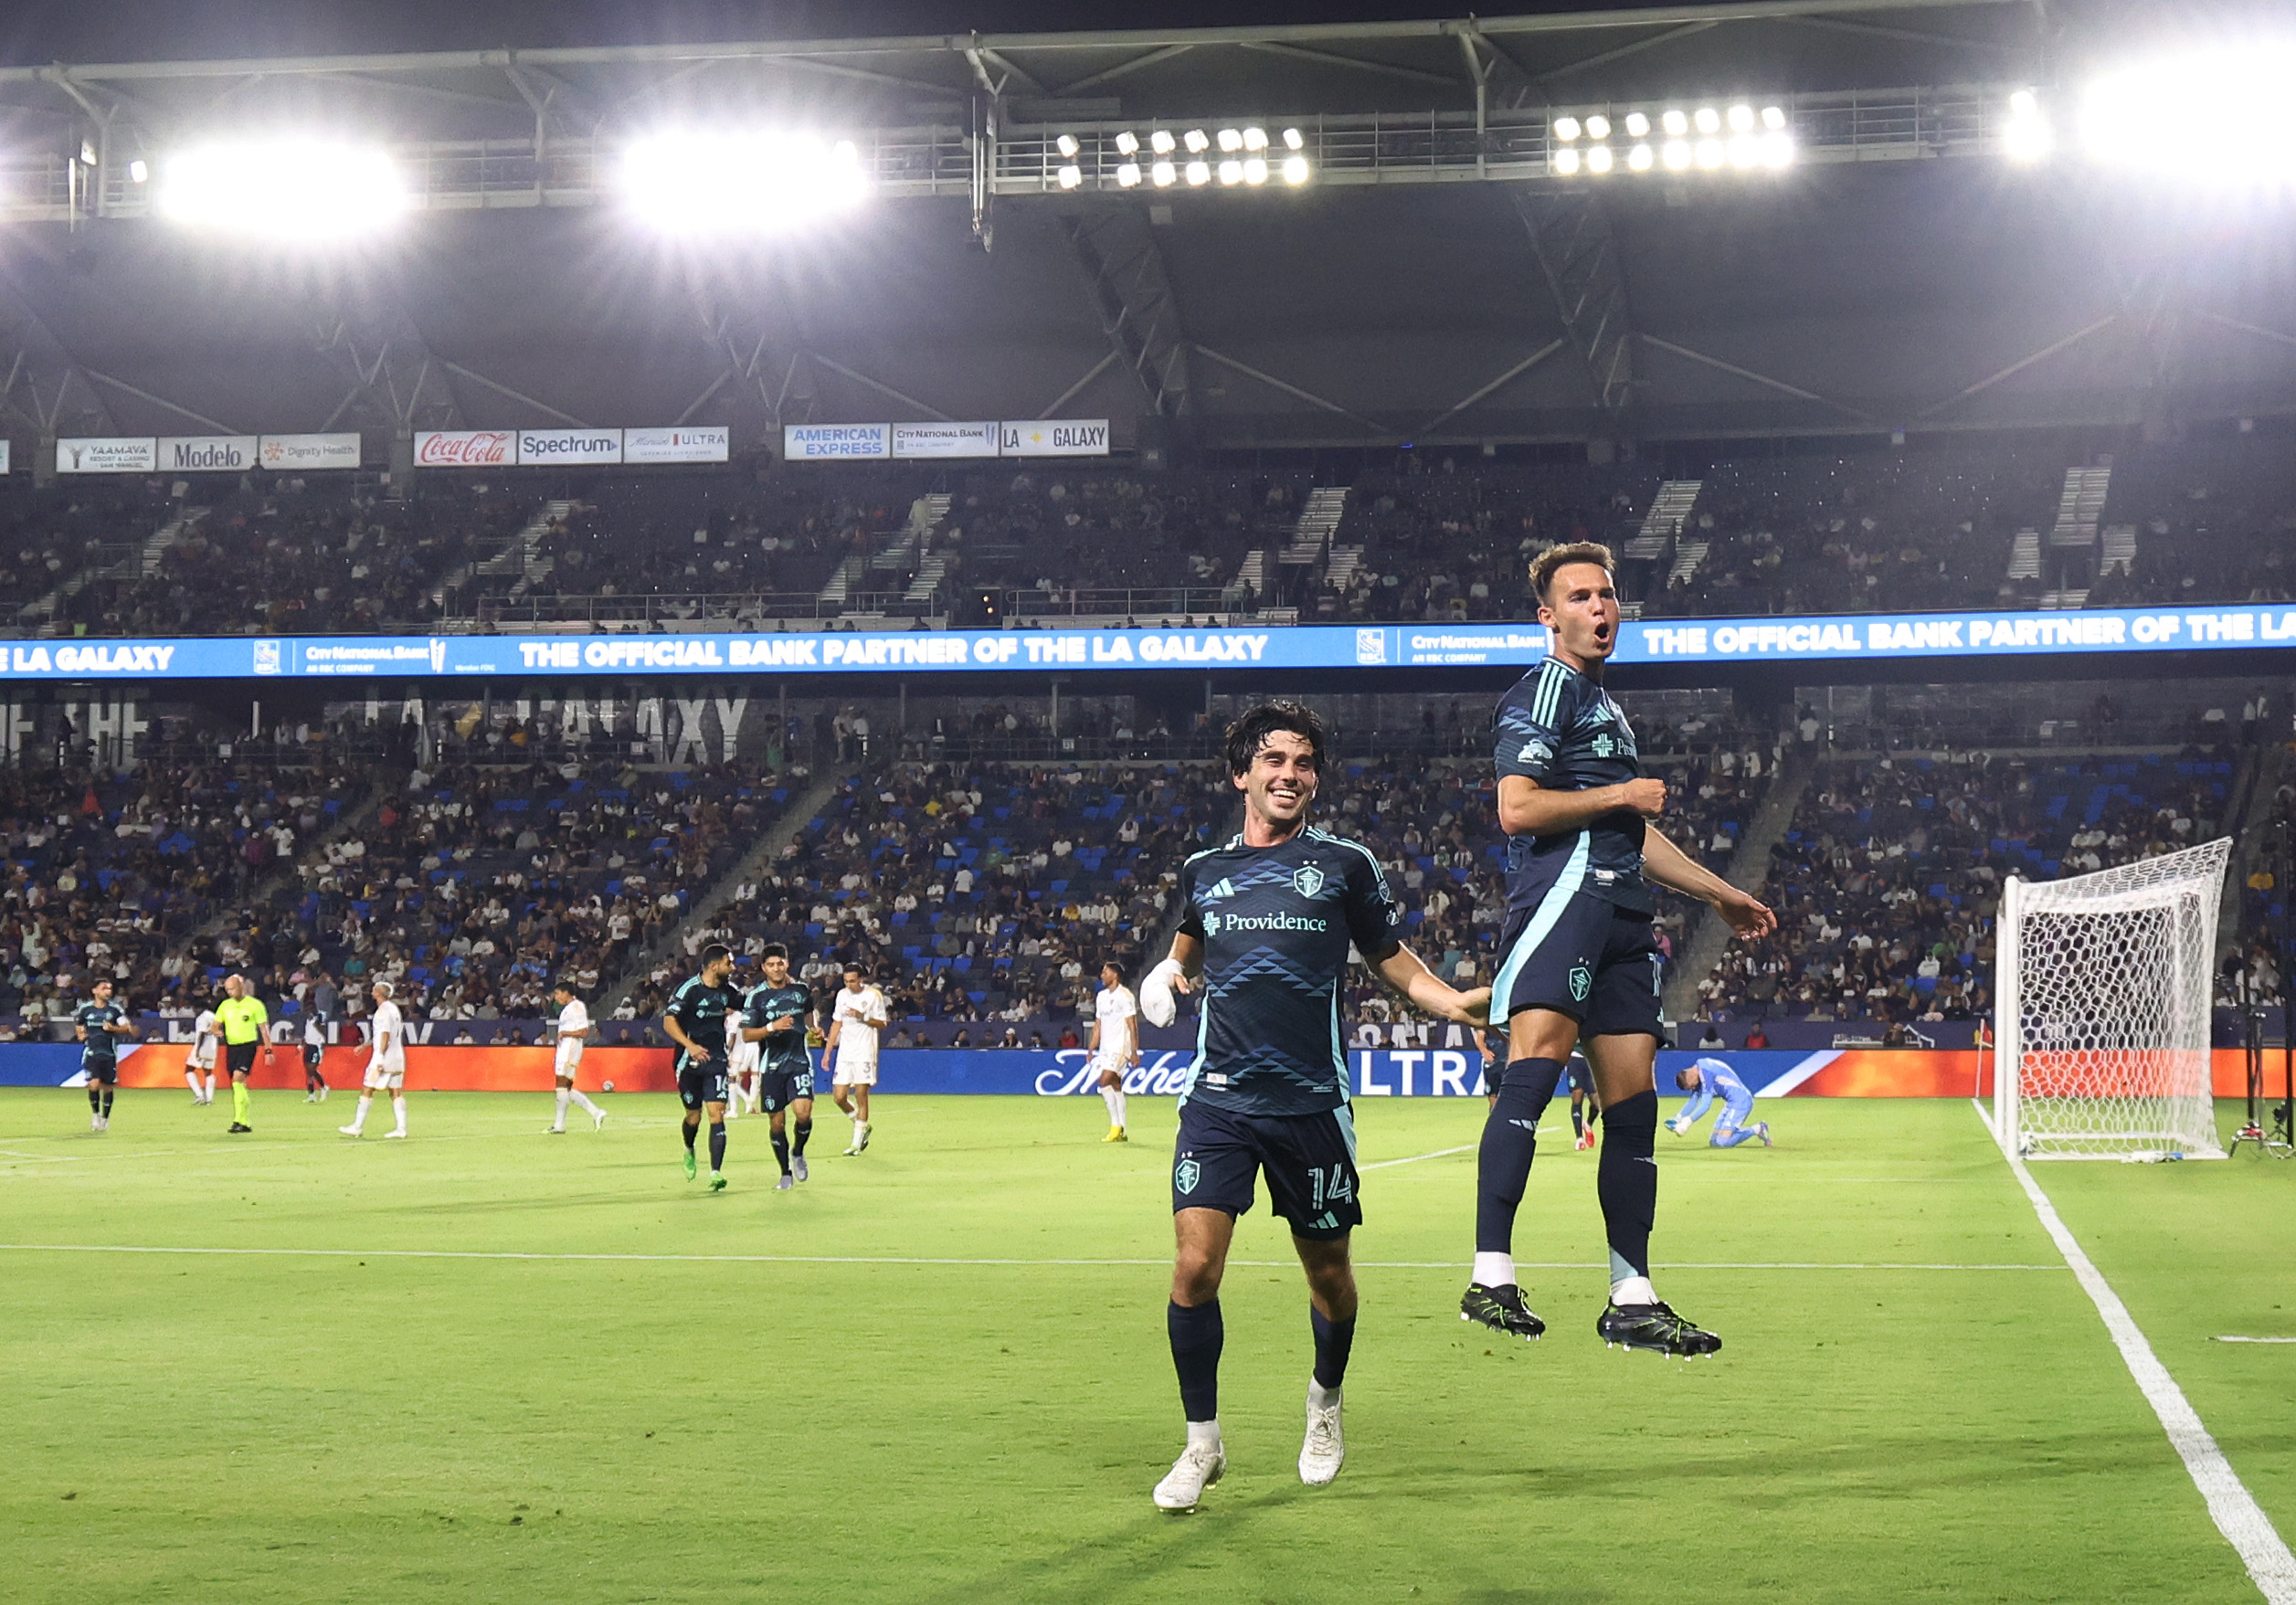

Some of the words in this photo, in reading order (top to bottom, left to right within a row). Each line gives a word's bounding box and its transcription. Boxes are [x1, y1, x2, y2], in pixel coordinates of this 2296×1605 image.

[682, 434, 725, 446] ULTRA
[793, 428, 882, 442] AMERICAN
[1003, 429, 1020, 449] LA
[1053, 427, 1106, 448] GALAXY
[174, 443, 241, 469] Modelo
[523, 436, 611, 457] Spectrum
[806, 442, 883, 455] EXPRESS
[1412, 635, 1440, 649] CITY
[1441, 635, 1507, 649] NATIONAL
[1507, 634, 1546, 649] BANK
[1643, 627, 1708, 655] THE
[1712, 624, 1861, 654] OFFICIAL
[1867, 620, 1963, 649] BANK
[1969, 617, 2126, 647] PARTNER
[2131, 616, 2181, 643] OF
[2185, 613, 2255, 642] THE
[2260, 612, 2296, 640] LA
[13, 647, 52, 672] LA
[55, 646, 175, 671] GALAXY
[518, 642, 580, 668] THE
[584, 641, 724, 668] OFFICIAL
[728, 640, 818, 666] BANK
[822, 638, 968, 665] PARTNER
[973, 638, 1019, 663] OF
[1023, 637, 1087, 663] THE
[1092, 636, 1135, 662] LA
[1138, 635, 1269, 661] GALAXY
[1444, 652, 1487, 663] COMPANY
[1224, 912, 1328, 933] Providence
[862, 1061, 872, 1073] 3
[793, 1073, 811, 1090] 18
[1307, 1161, 1353, 1210] 14
